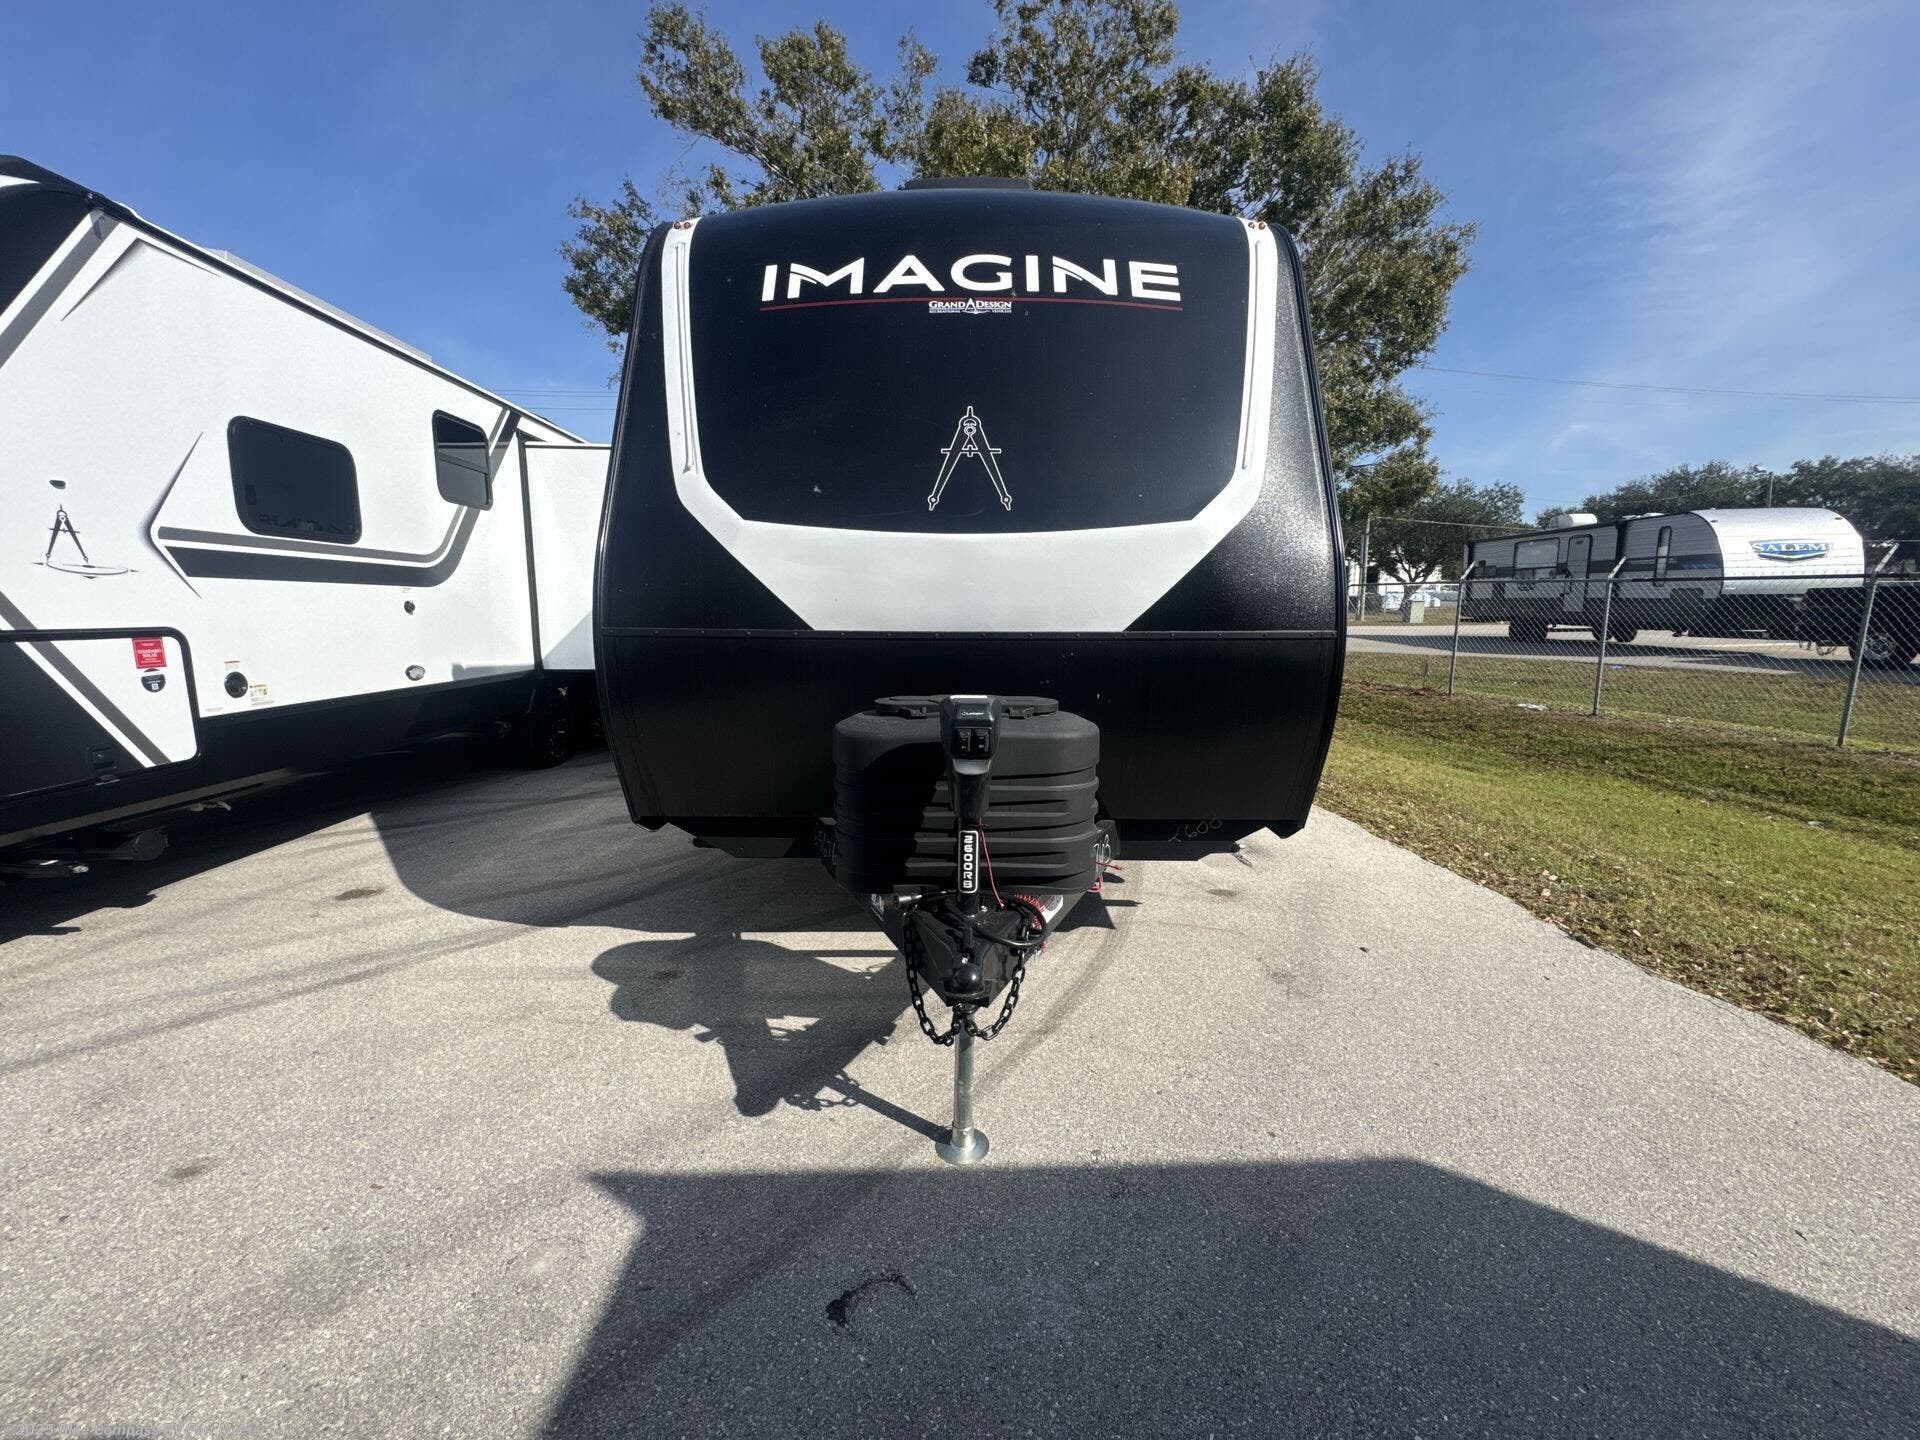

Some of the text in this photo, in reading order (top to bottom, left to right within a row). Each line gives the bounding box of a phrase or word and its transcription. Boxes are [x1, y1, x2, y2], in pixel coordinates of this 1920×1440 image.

[761, 254, 1181, 301] IMAGINE
[928, 300, 1012, 308] GRAND DESIGN
[1752, 542, 1827, 552] SALEM
[1168, 817, 1223, 842] 2600
[963, 835, 974, 889] 2600RB
